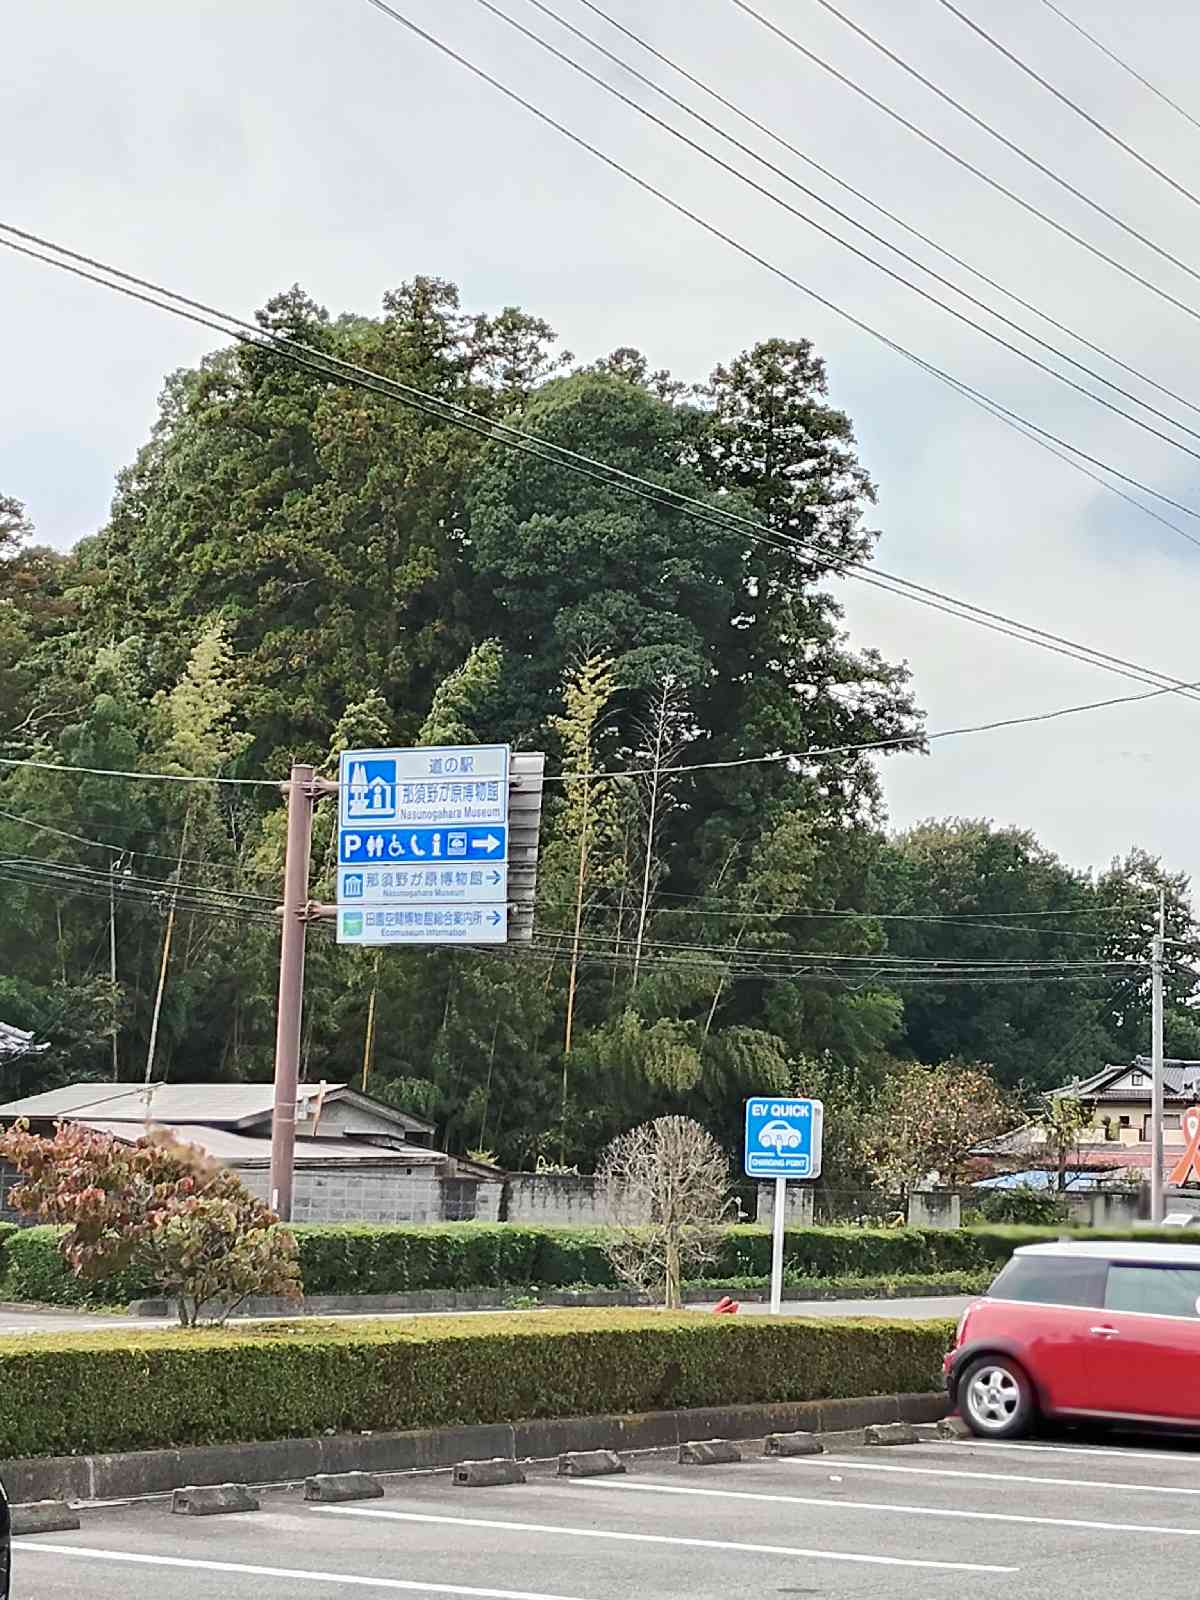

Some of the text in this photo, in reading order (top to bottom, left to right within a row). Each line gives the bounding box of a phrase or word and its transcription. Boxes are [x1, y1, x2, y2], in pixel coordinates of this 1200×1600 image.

[429, 756, 474, 774] 道の駅
[401, 782, 499, 803] 那須野が原博物館
[400, 806, 500, 821] Nasunogahara Museum
[345, 835, 362, 858] P
[366, 871, 483, 888] 那須野が原博物館
[383, 888, 465, 898] Nasunogahara Museum
[381, 928, 467, 937] Ecomuseum Information
[751, 1104, 809, 1117] EV QUICK
